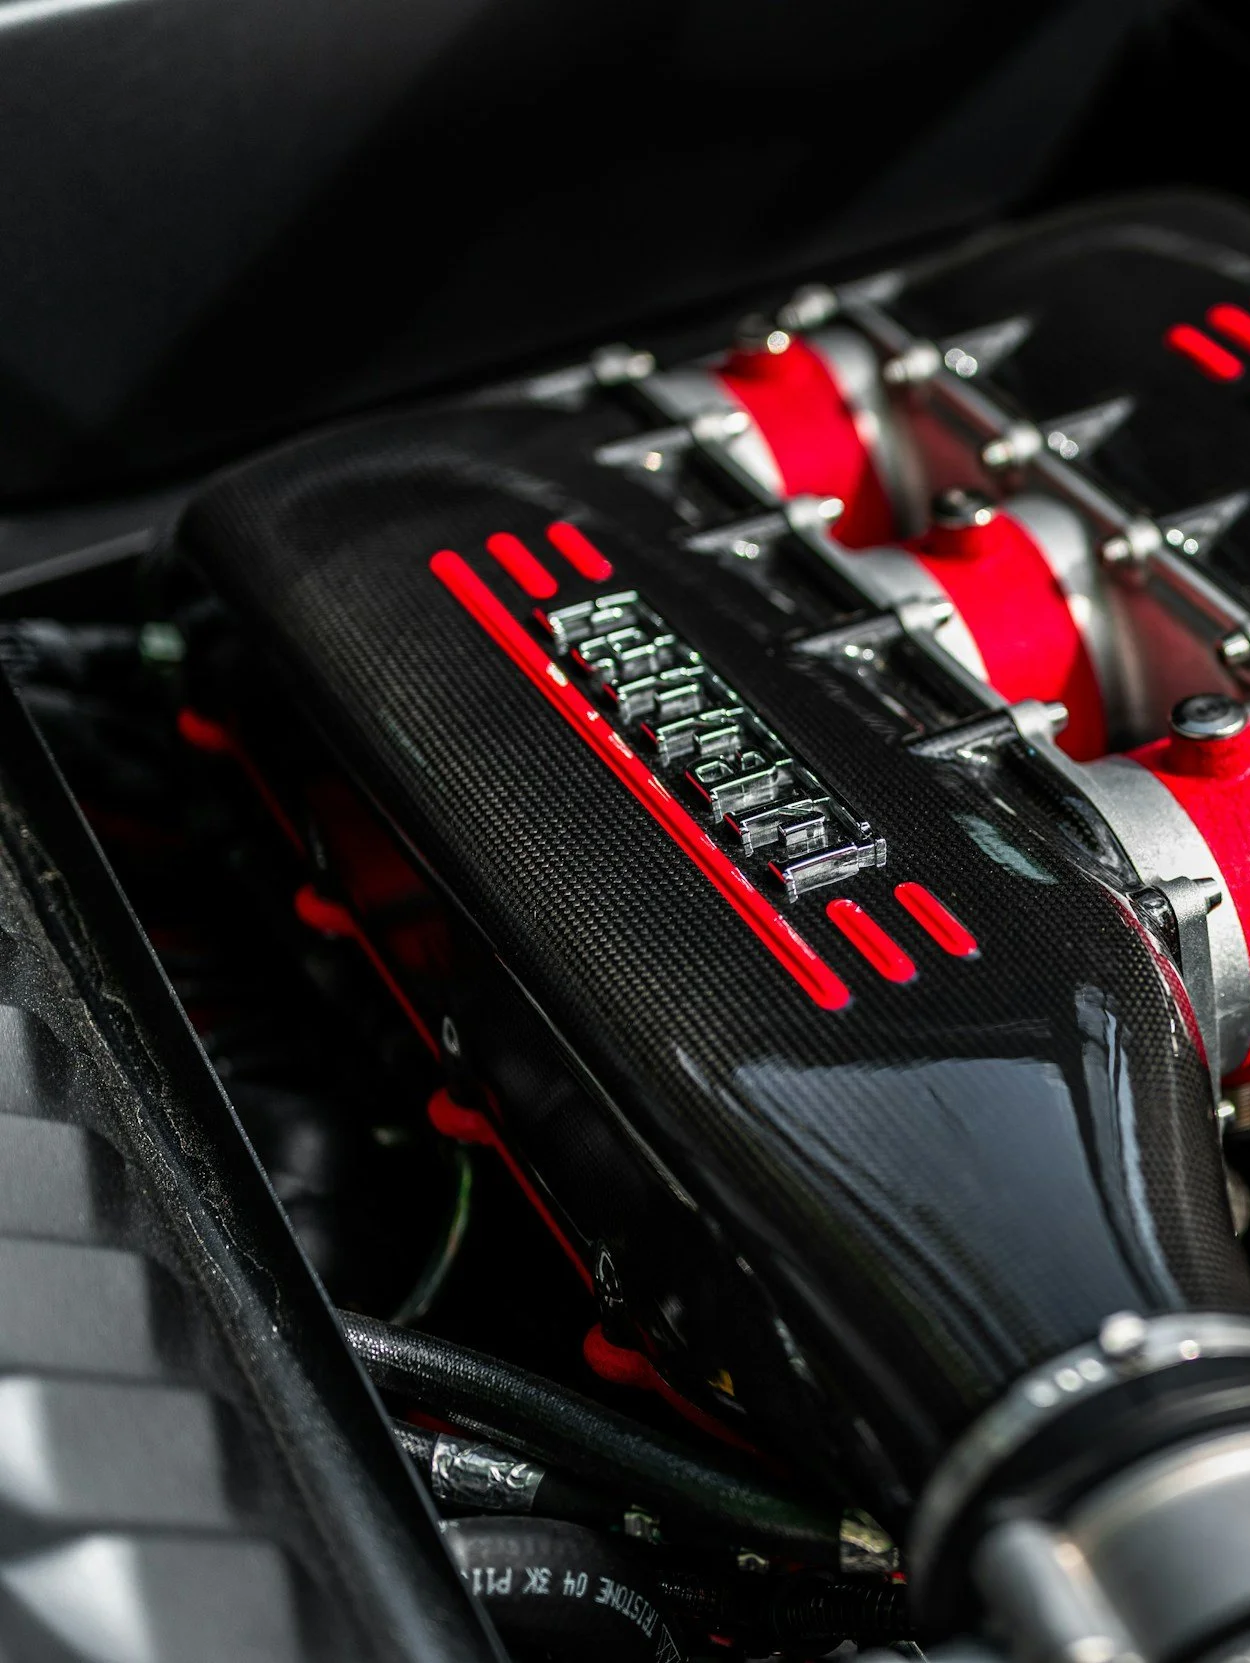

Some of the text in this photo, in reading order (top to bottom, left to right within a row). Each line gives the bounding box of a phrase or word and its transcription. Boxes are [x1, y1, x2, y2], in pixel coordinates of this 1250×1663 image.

[461, 1566, 512, 1596] P11
[562, 1570, 588, 1598] 04
[595, 1576, 658, 1638] TRISTONE
